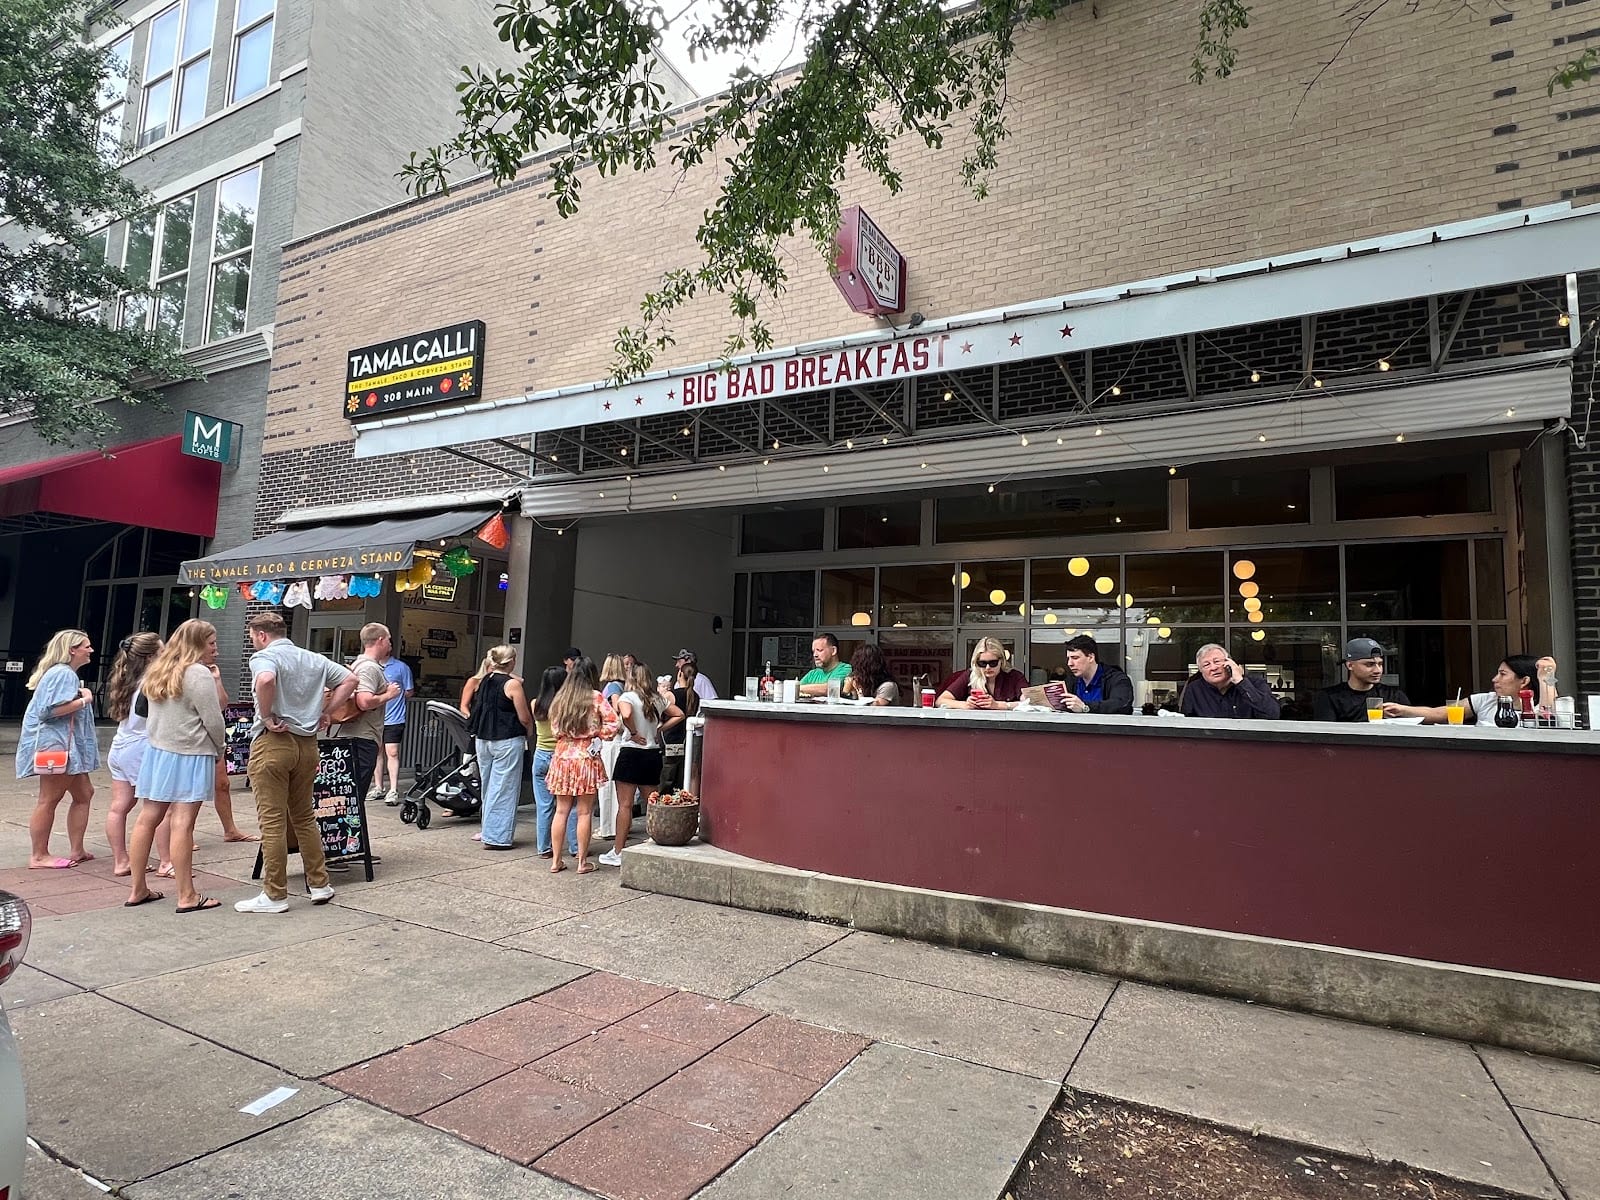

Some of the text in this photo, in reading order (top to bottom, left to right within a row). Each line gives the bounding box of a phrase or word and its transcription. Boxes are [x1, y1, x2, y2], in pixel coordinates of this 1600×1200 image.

[350, 328, 476, 378] TAMALCALLI
[392, 372, 408, 381] TACO
[417, 365, 448, 377] CERVEZA
[450, 359, 472, 370] STAND
[682, 334, 951, 406] BIG BAD BREAKFAST
[383, 385, 434, 403] 308 MAIN
[193, 415, 222, 448] M
[191, 446, 220, 458] LOFTS
[193, 441, 220, 453] MANN
[187, 568, 206, 579] THE
[256, 562, 284, 575] TACO
[288, 561, 295, 572] &
[301, 556, 353, 571] CERVEZA
[361, 551, 402, 565] STAND
[316, 759, 346, 776] PEN
[321, 830, 347, 845] rink
